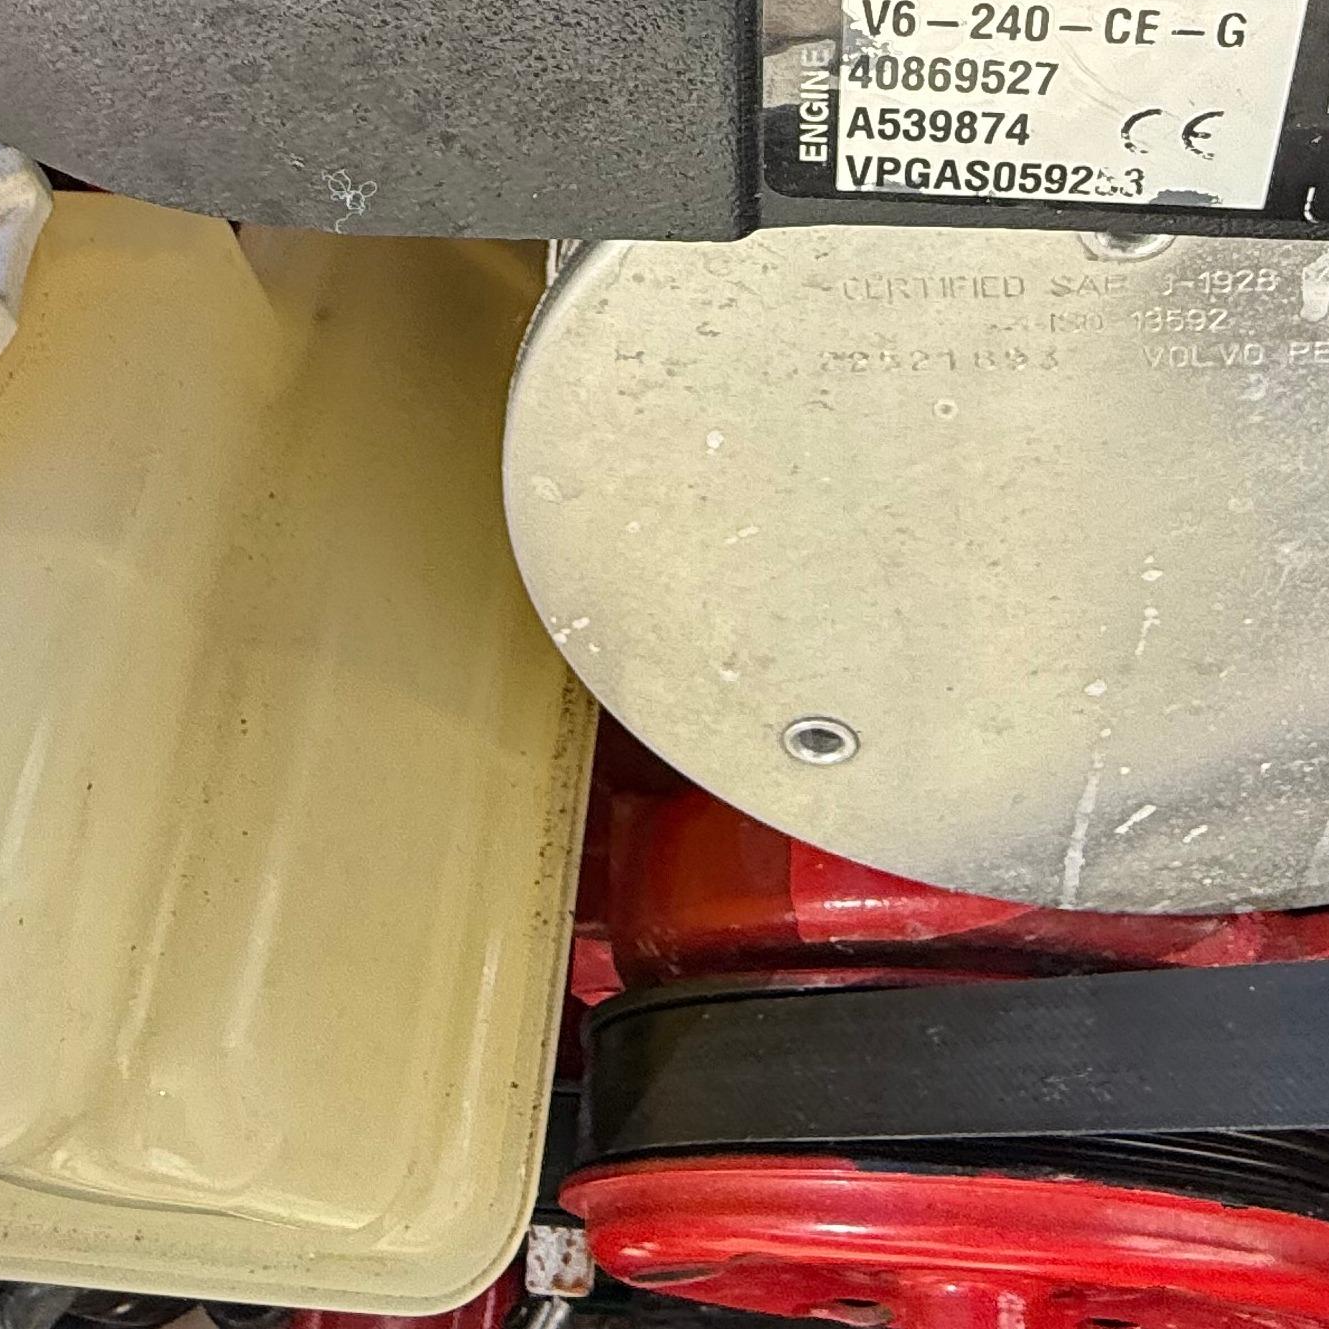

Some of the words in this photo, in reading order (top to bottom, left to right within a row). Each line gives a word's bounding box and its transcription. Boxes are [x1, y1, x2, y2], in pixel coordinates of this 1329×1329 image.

[846, 56, 1059, 96] 40869527
[799, 47, 833, 164] ENGINE
[846, 105, 1031, 146] A539874
[1141, 341, 1266, 369] VOLVO
